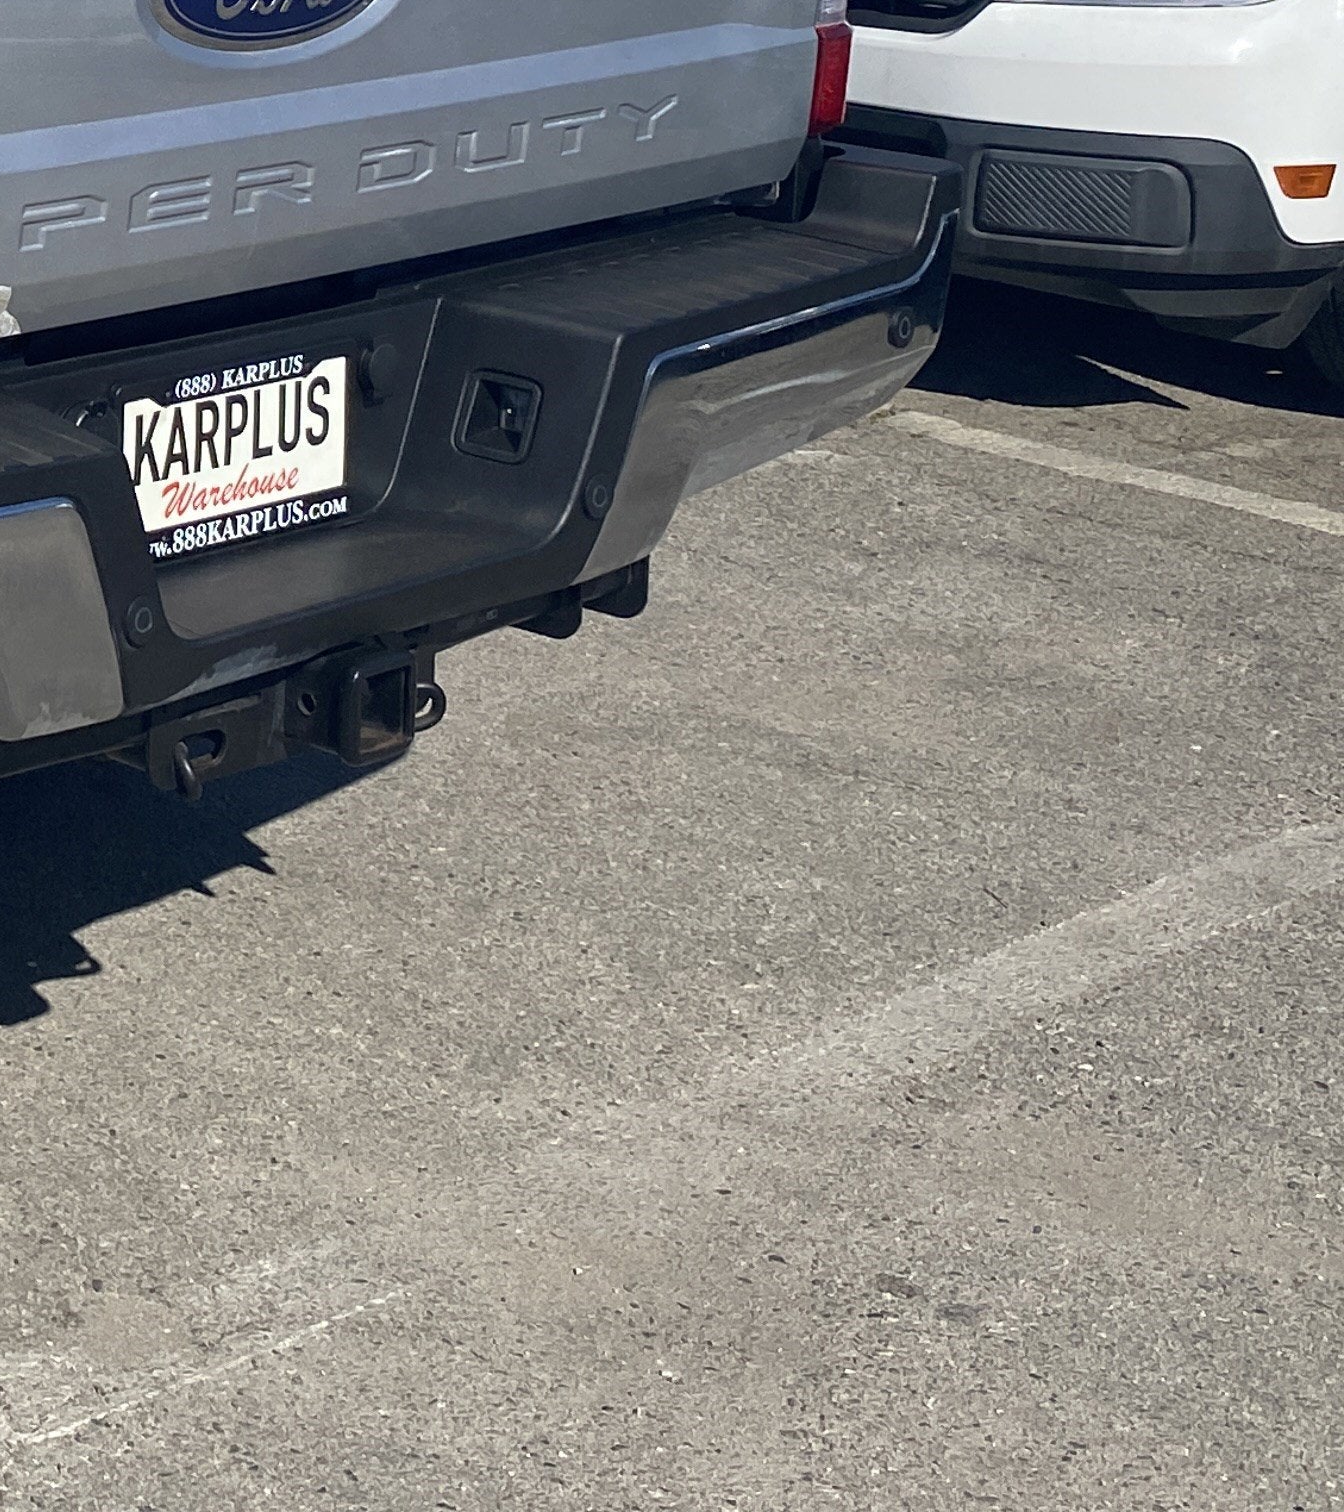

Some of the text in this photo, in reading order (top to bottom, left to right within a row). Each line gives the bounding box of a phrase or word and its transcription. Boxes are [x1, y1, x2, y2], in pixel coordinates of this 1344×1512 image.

[356, 93, 679, 193] DUTY
[175, 354, 304, 399] (888) KARPLUS
[132, 375, 331, 487] KARPLUS
[161, 463, 300, 520] Warehouse
